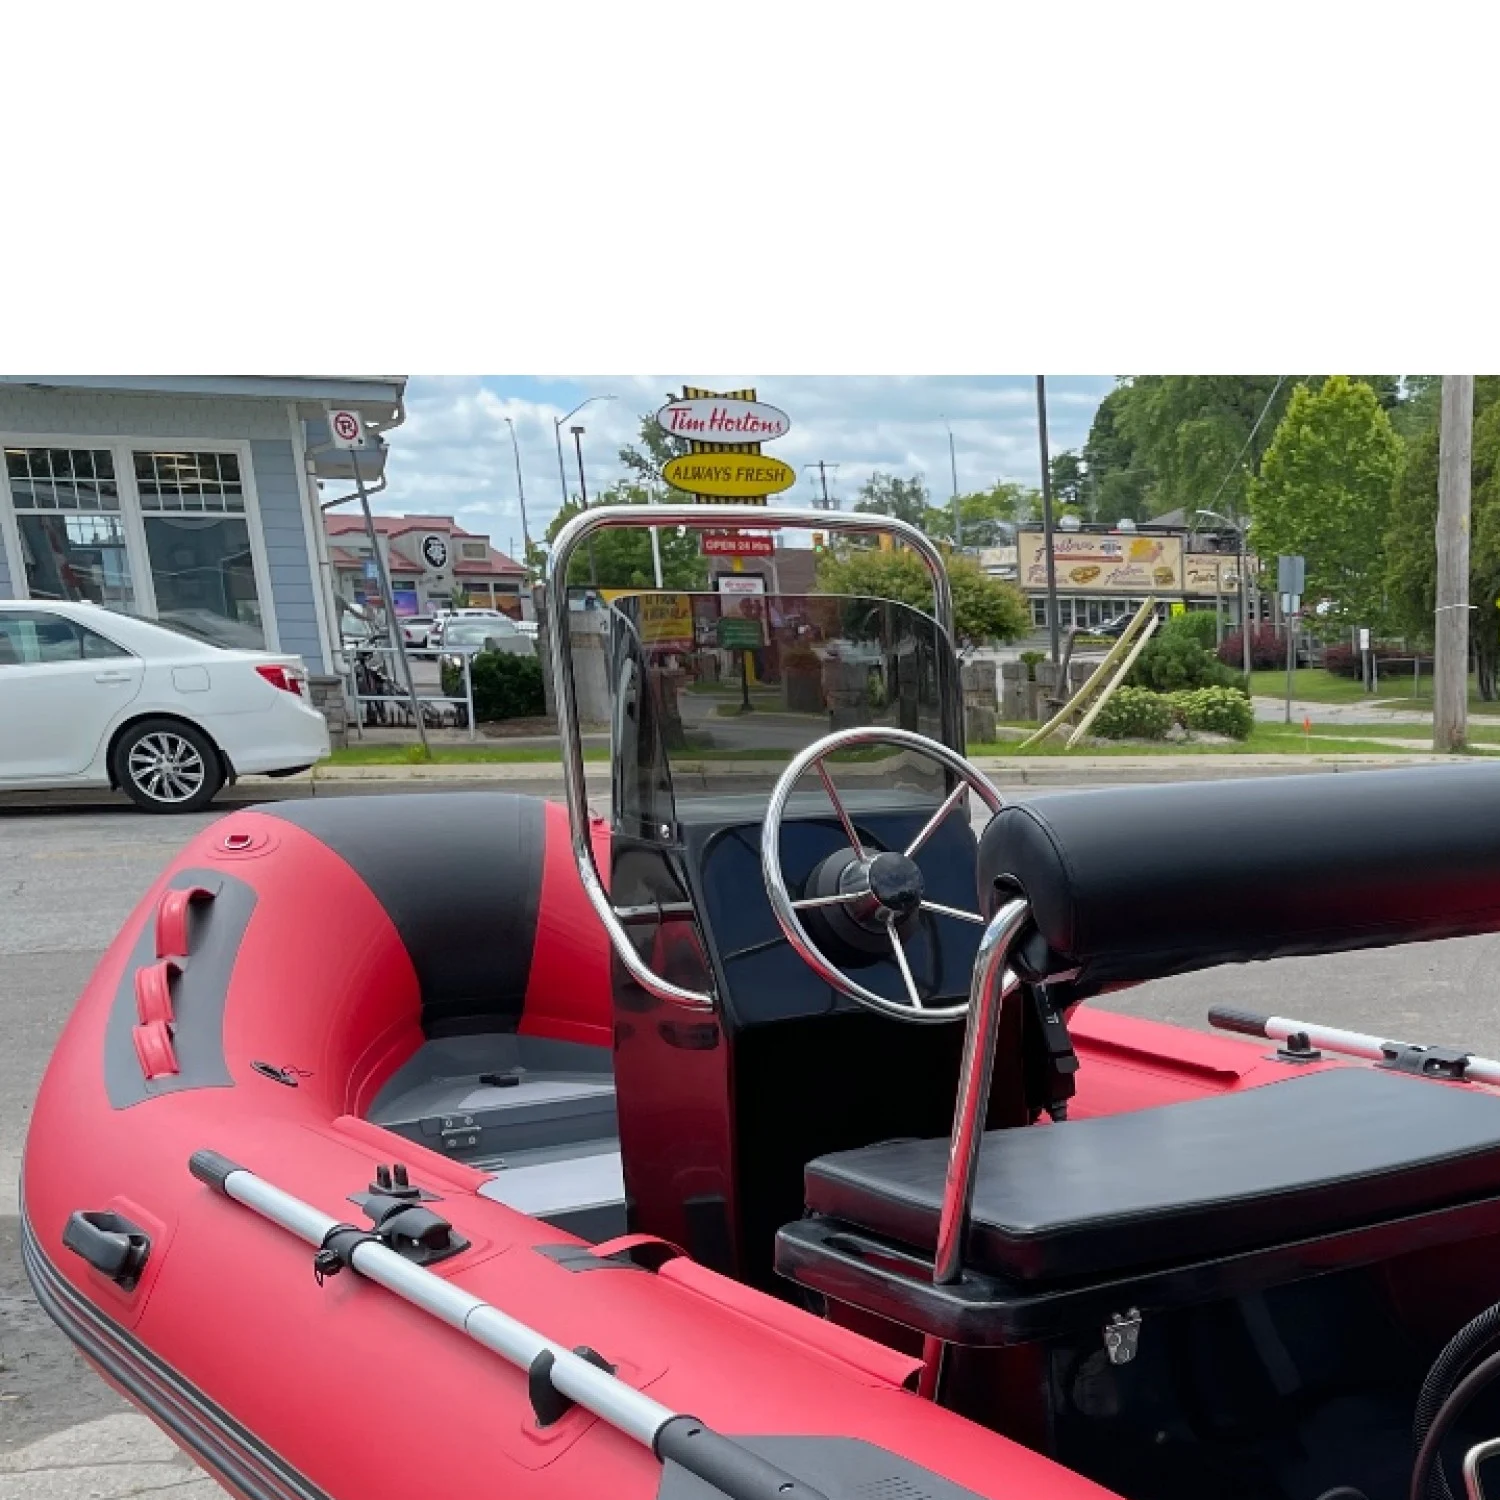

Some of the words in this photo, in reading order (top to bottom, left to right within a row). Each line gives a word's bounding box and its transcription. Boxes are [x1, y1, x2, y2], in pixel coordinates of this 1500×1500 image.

[668, 407, 706, 432] Tim
[709, 407, 782, 434] Hortons
[672, 465, 732, 483] ALWAYS
[734, 466, 787, 483] FRESH
